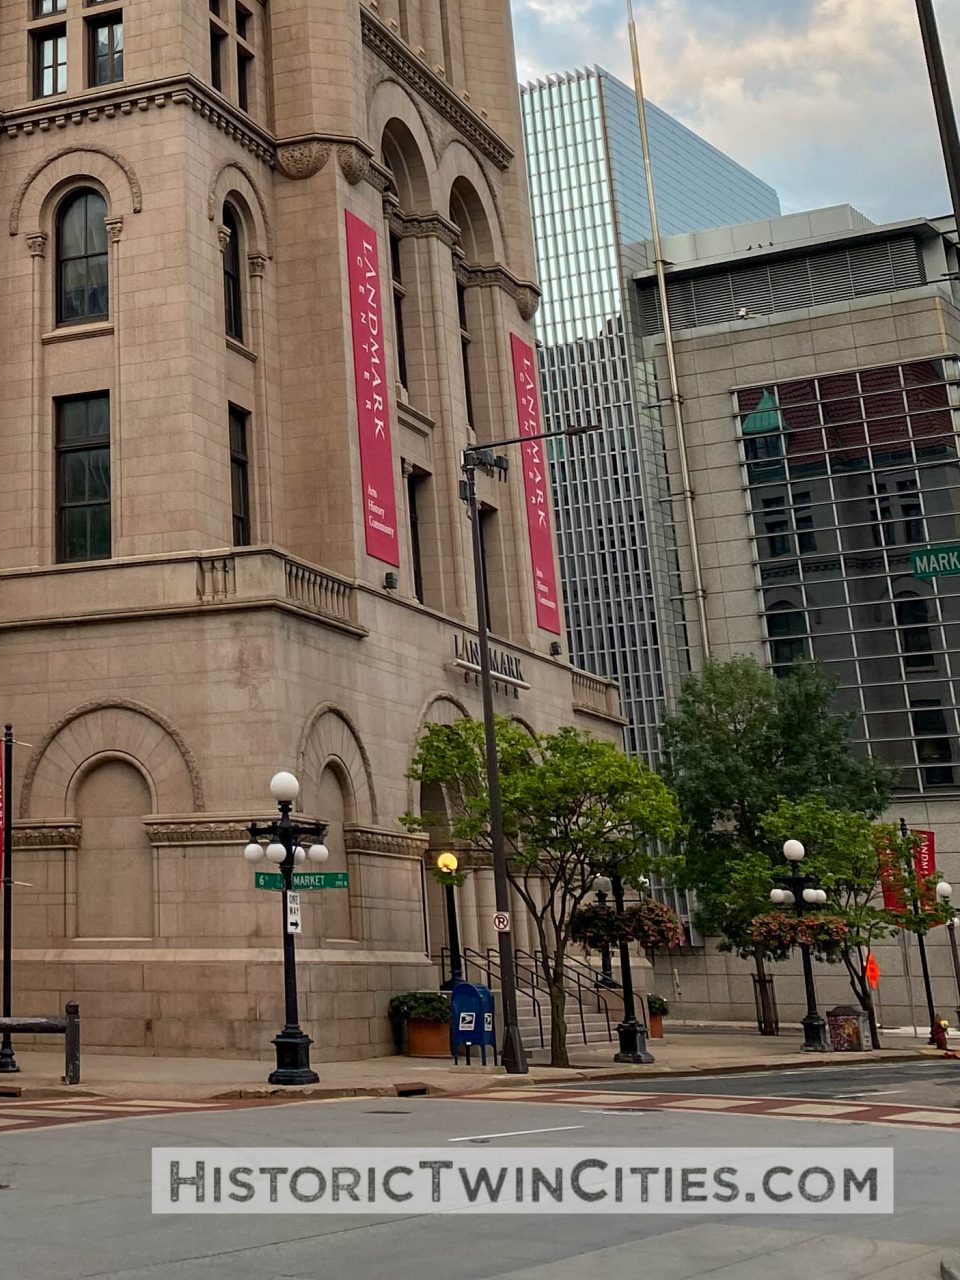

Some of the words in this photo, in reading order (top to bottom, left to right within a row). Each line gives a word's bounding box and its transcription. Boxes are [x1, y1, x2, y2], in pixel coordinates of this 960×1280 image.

[356, 256, 372, 410] CENTER
[363, 240, 385, 440] LANDMARK
[520, 372, 536, 504] CENTER
[523, 358, 547, 528] LANDMARK
[368, 499, 385, 520] History
[368, 515, 394, 539] Community
[453, 630, 525, 682] LANMARK
[293, 875, 325, 886] MARKET
[289, 894, 299, 906] ONE
[289, 906, 299, 916] WAY
